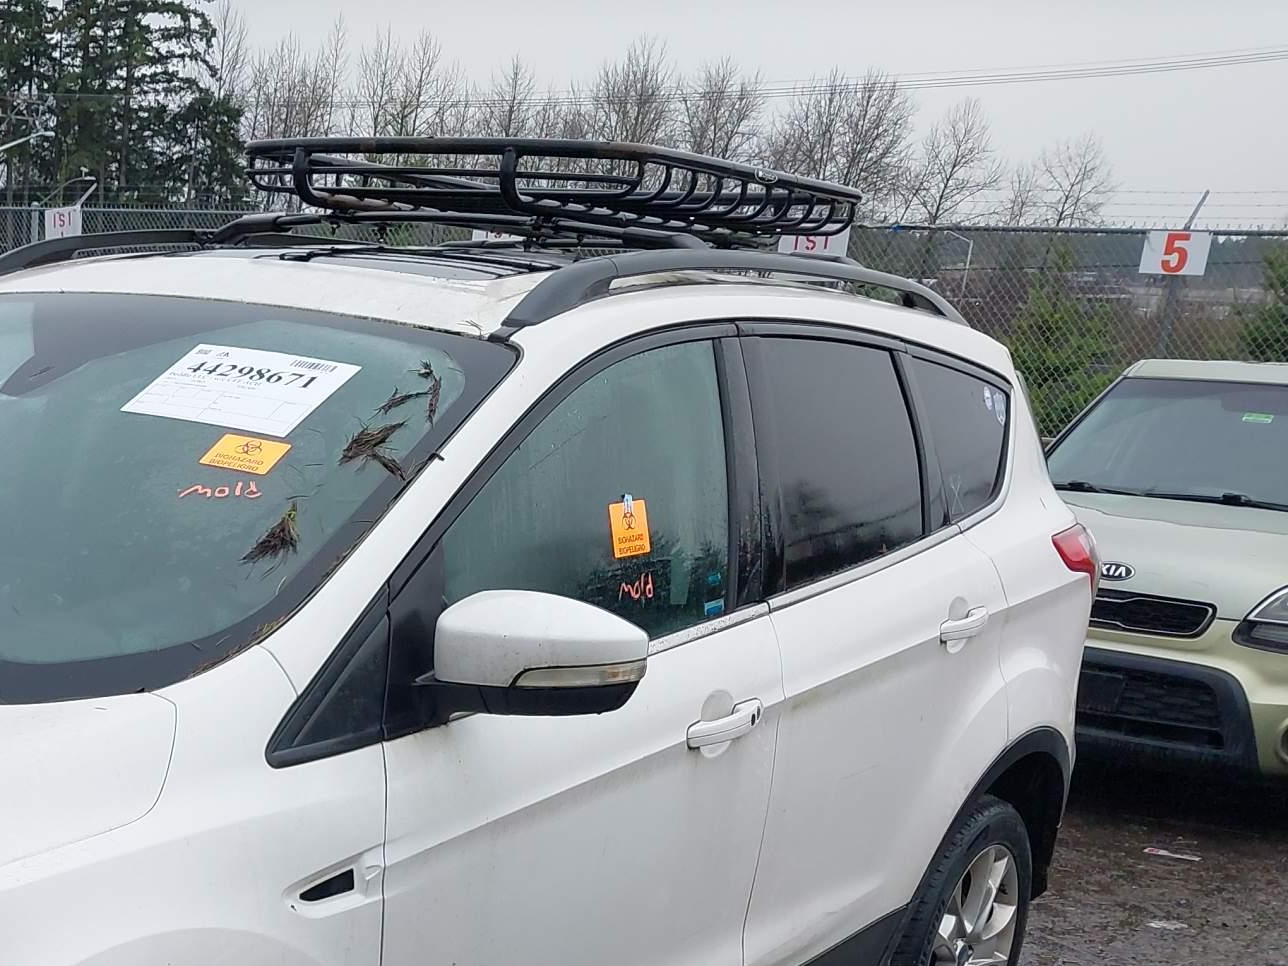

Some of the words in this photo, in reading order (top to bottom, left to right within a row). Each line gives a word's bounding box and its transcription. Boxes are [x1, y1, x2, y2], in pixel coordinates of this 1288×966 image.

[1160, 232, 1192, 273] 5
[186, 360, 319, 389] 44298671
[209, 458, 259, 472] BIOPELIGRO
[214, 453, 264, 467] BIOHAZARD
[1101, 564, 1127, 577] KIA
[618, 572, 654, 601] mold
